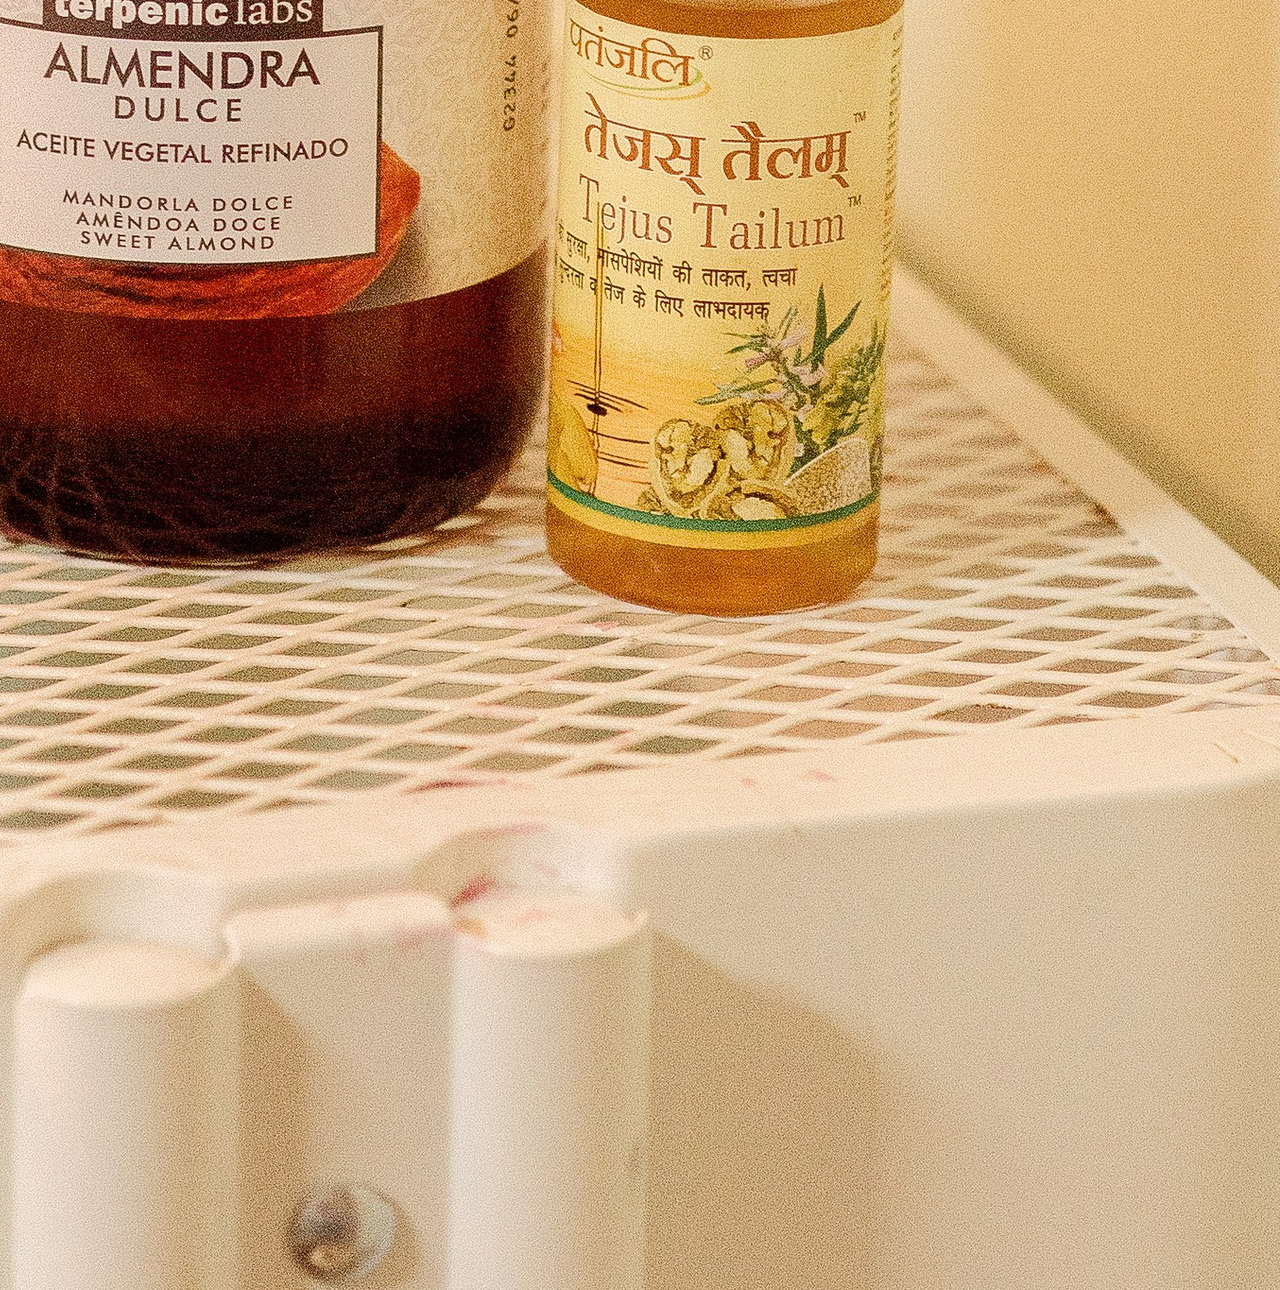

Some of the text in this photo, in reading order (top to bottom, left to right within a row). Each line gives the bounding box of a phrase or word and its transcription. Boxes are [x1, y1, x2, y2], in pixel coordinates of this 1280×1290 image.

[43, 41, 321, 90] ALMENDRA
[570, 18, 695, 87] पतंजलि
[114, 95, 243, 123] DULCE
[17, 129, 349, 164] ACEITE VEGETAL REFINADO
[584, 91, 707, 196] तेजस्
[721, 120, 852, 188] तैलम्
[63, 189, 294, 212] MANDORLA DOLCE
[579, 173, 673, 244] Tejus
[692, 202, 846, 251] Tailum
[76, 212, 281, 232] AMÊNDOA DOCE
[80, 231, 275, 251] SWEET ALMOND
[672, 260, 693, 285] की
[762, 267, 799, 287] त्वचा
[603, 275, 626, 305] तेज
[632, 284, 647, 309] के
[654, 289, 685, 318] लिए
[693, 299, 771, 322] लाभदायक
